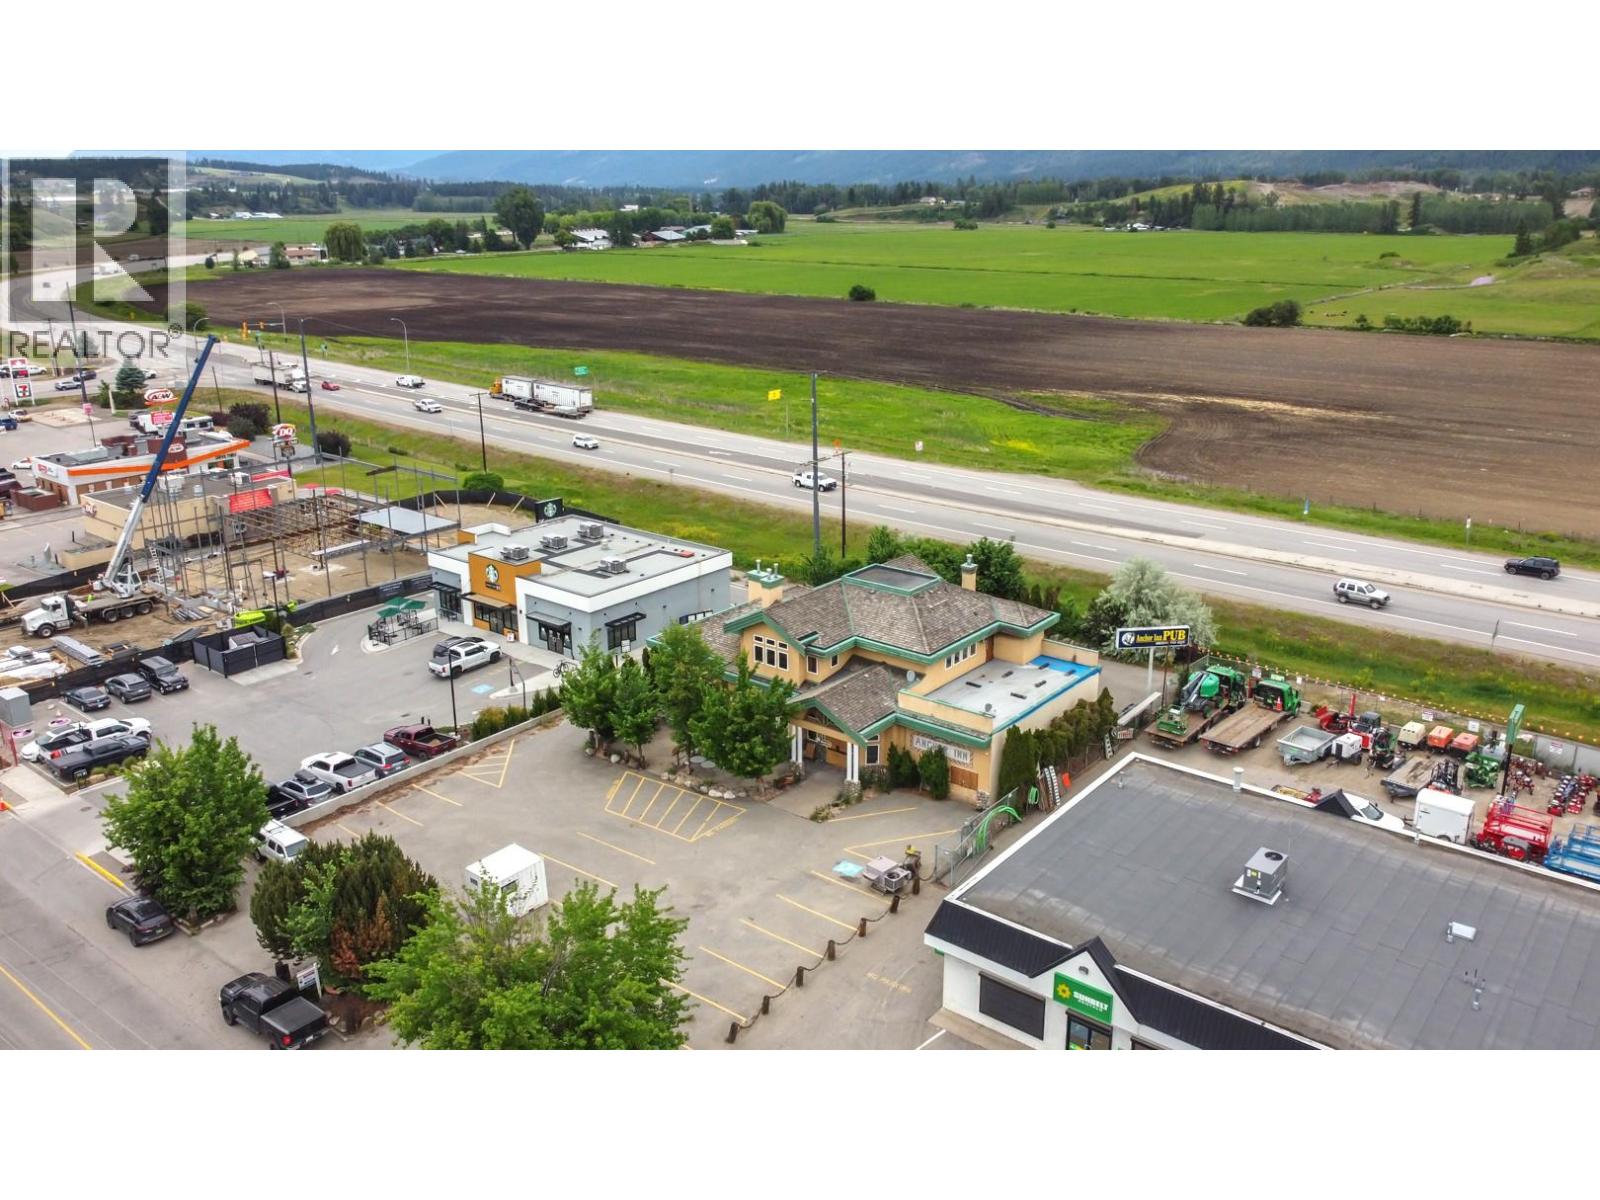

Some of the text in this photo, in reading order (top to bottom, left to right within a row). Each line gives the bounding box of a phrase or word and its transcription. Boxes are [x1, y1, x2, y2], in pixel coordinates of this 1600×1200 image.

[279, 427, 293, 437] DQ
[1163, 629, 1186, 641] PUB
[954, 749, 968, 761] INN
